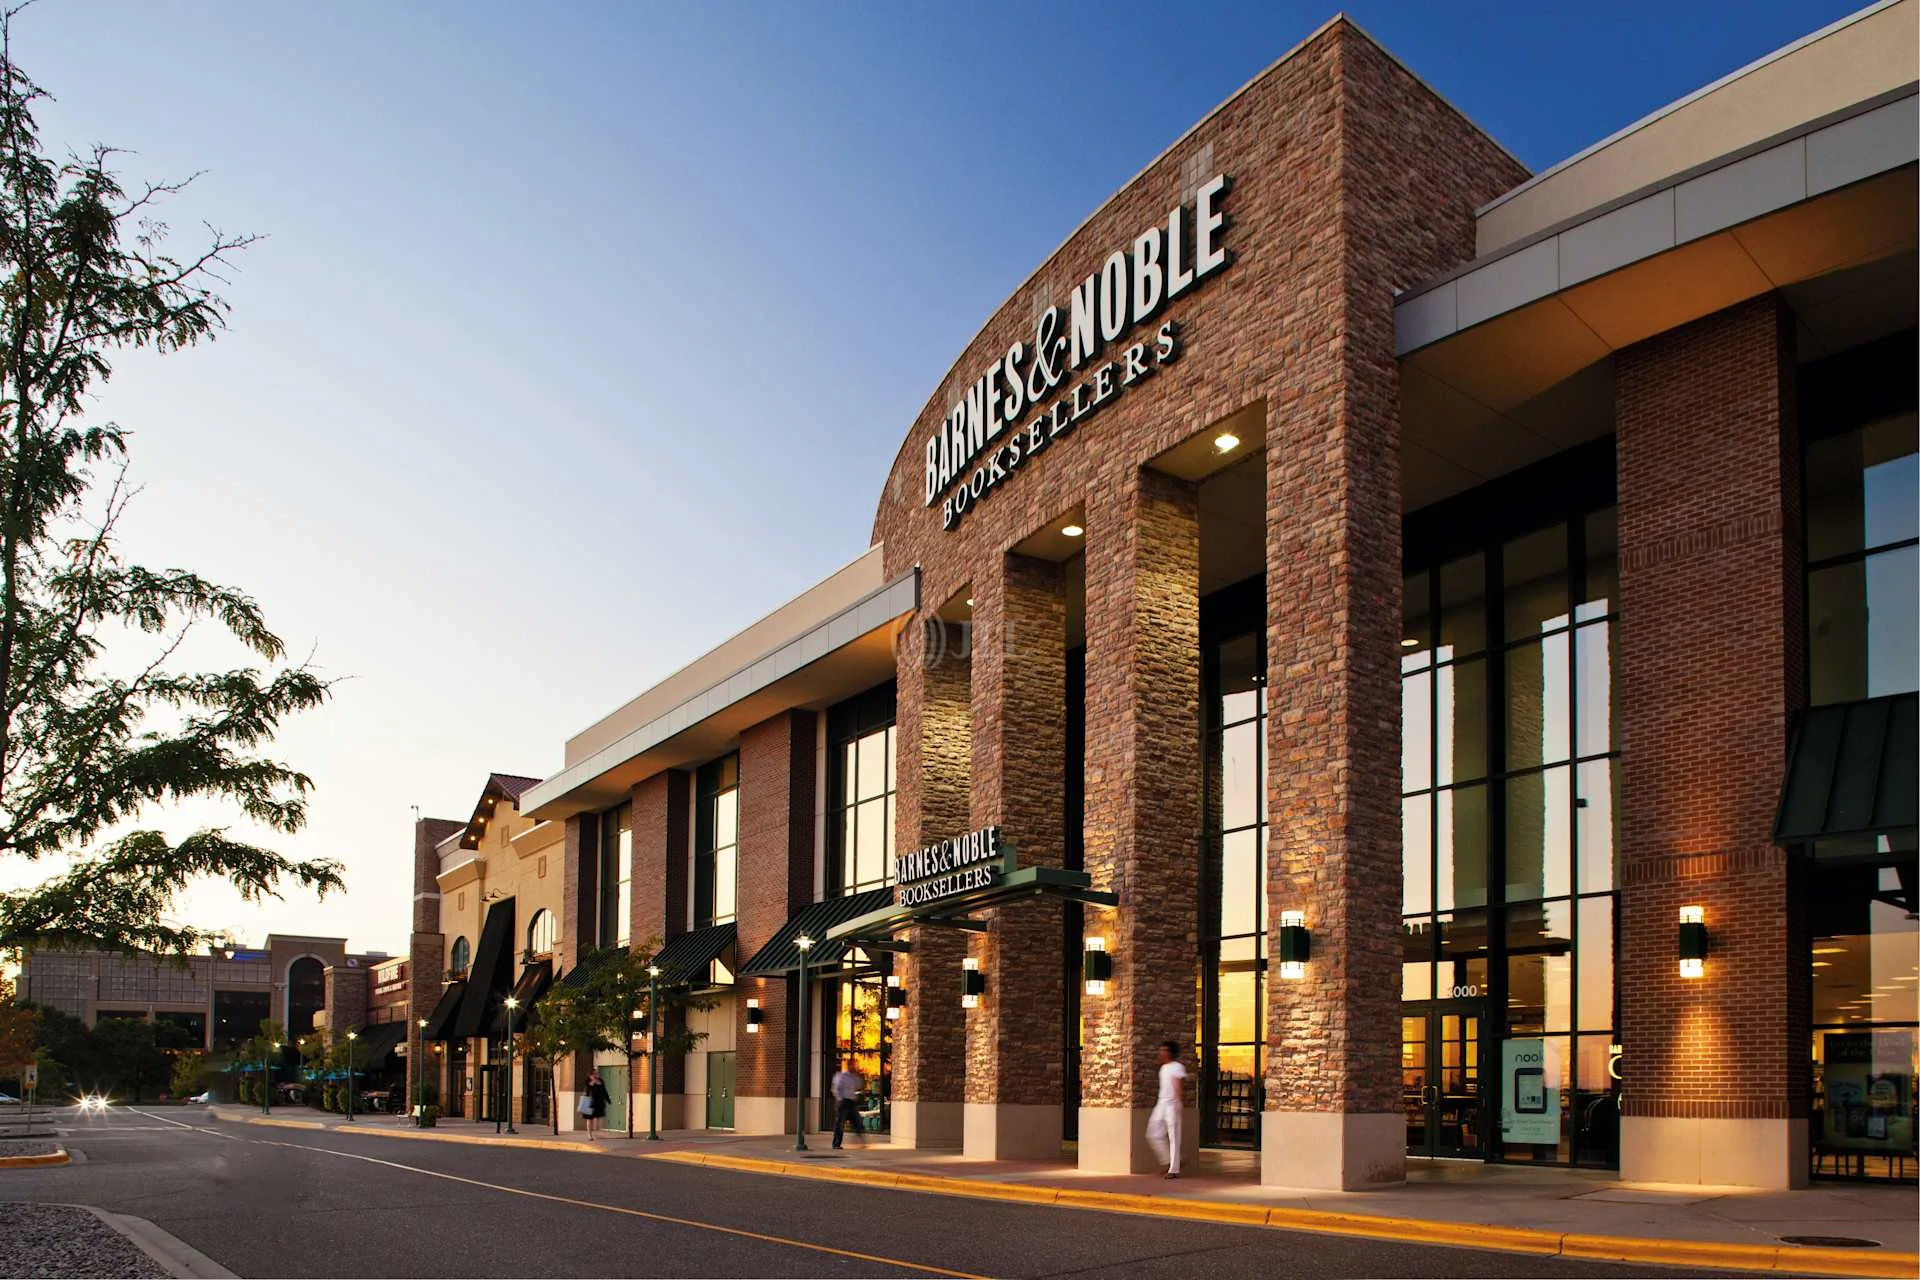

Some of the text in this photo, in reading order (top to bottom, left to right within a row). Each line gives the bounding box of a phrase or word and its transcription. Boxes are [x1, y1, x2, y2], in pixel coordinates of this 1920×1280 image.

[925, 340, 1025, 507] BARNES
[1070, 173, 1228, 370] NOBLE
[942, 320, 1177, 531] BOOKSELLERS
[894, 844, 939, 885] BARNES
[953, 825, 997, 868] NOBLE
[899, 865, 993, 908] BOOKSELLERS
